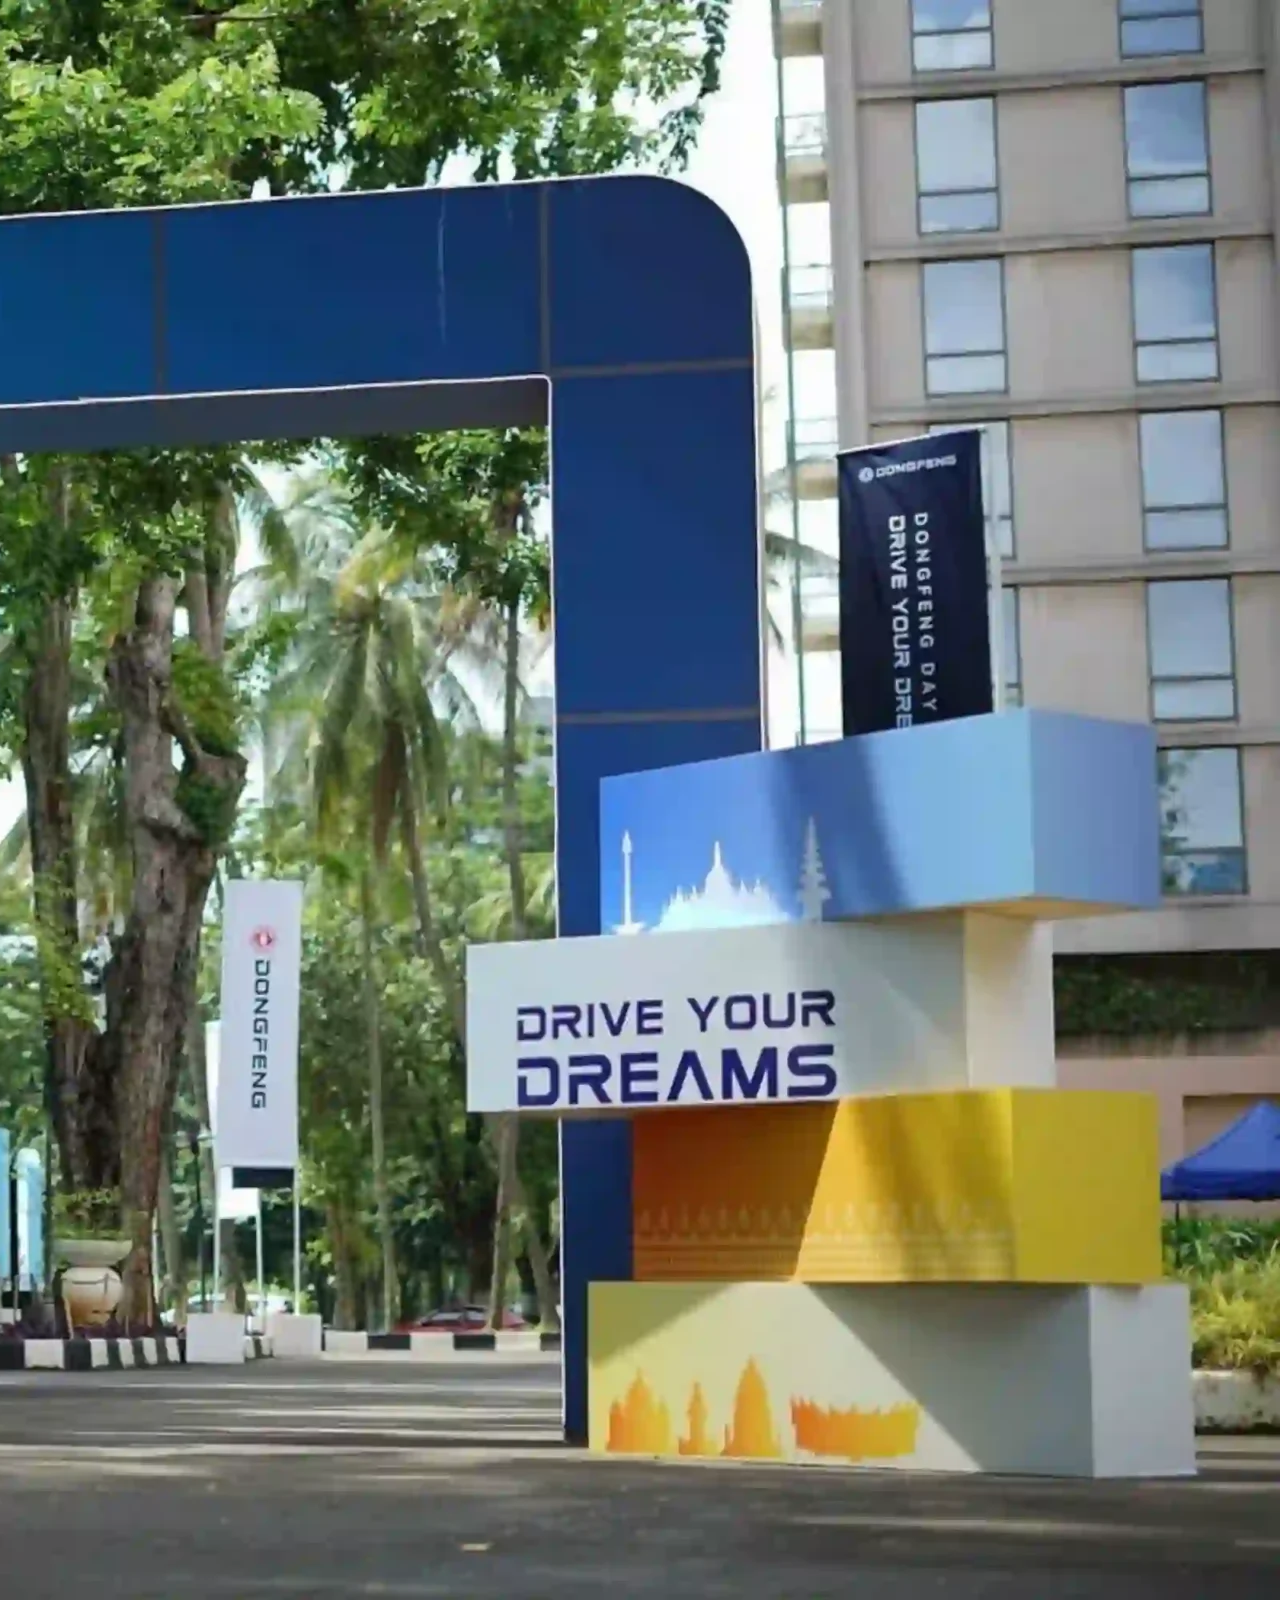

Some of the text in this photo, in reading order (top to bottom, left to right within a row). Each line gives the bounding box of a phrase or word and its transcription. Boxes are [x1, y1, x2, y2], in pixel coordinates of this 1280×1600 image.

[876, 454, 957, 478] DONGFENG
[888, 514, 908, 590] DRIVE
[892, 598, 911, 669] YOUR
[915, 512, 937, 712] DONGFENG DAY
[251, 959, 270, 1109] DONGFENG
[517, 989, 836, 1041] DRIVE YOUR
[517, 1043, 838, 1107] DREAMS
